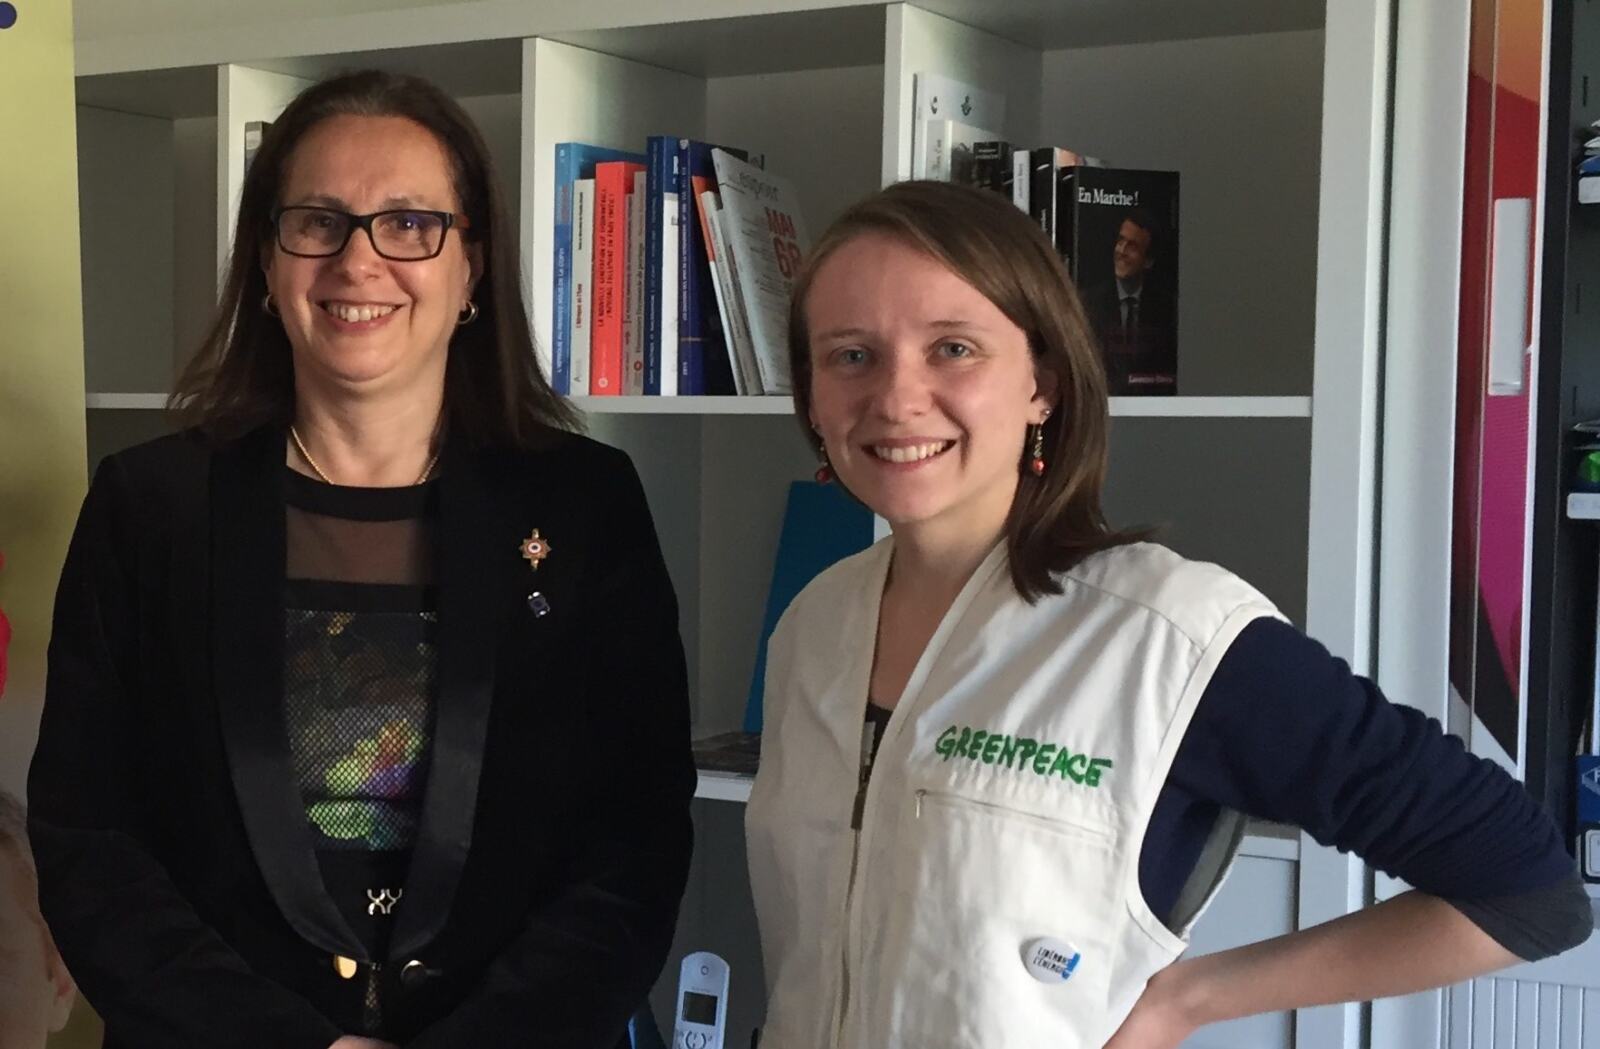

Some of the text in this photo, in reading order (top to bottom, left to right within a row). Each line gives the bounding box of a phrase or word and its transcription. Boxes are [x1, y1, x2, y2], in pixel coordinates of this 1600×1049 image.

[1077, 186, 1092, 204] En
[1092, 187, 1134, 206] Marche
[934, 724, 1113, 788] GREENPEACE
